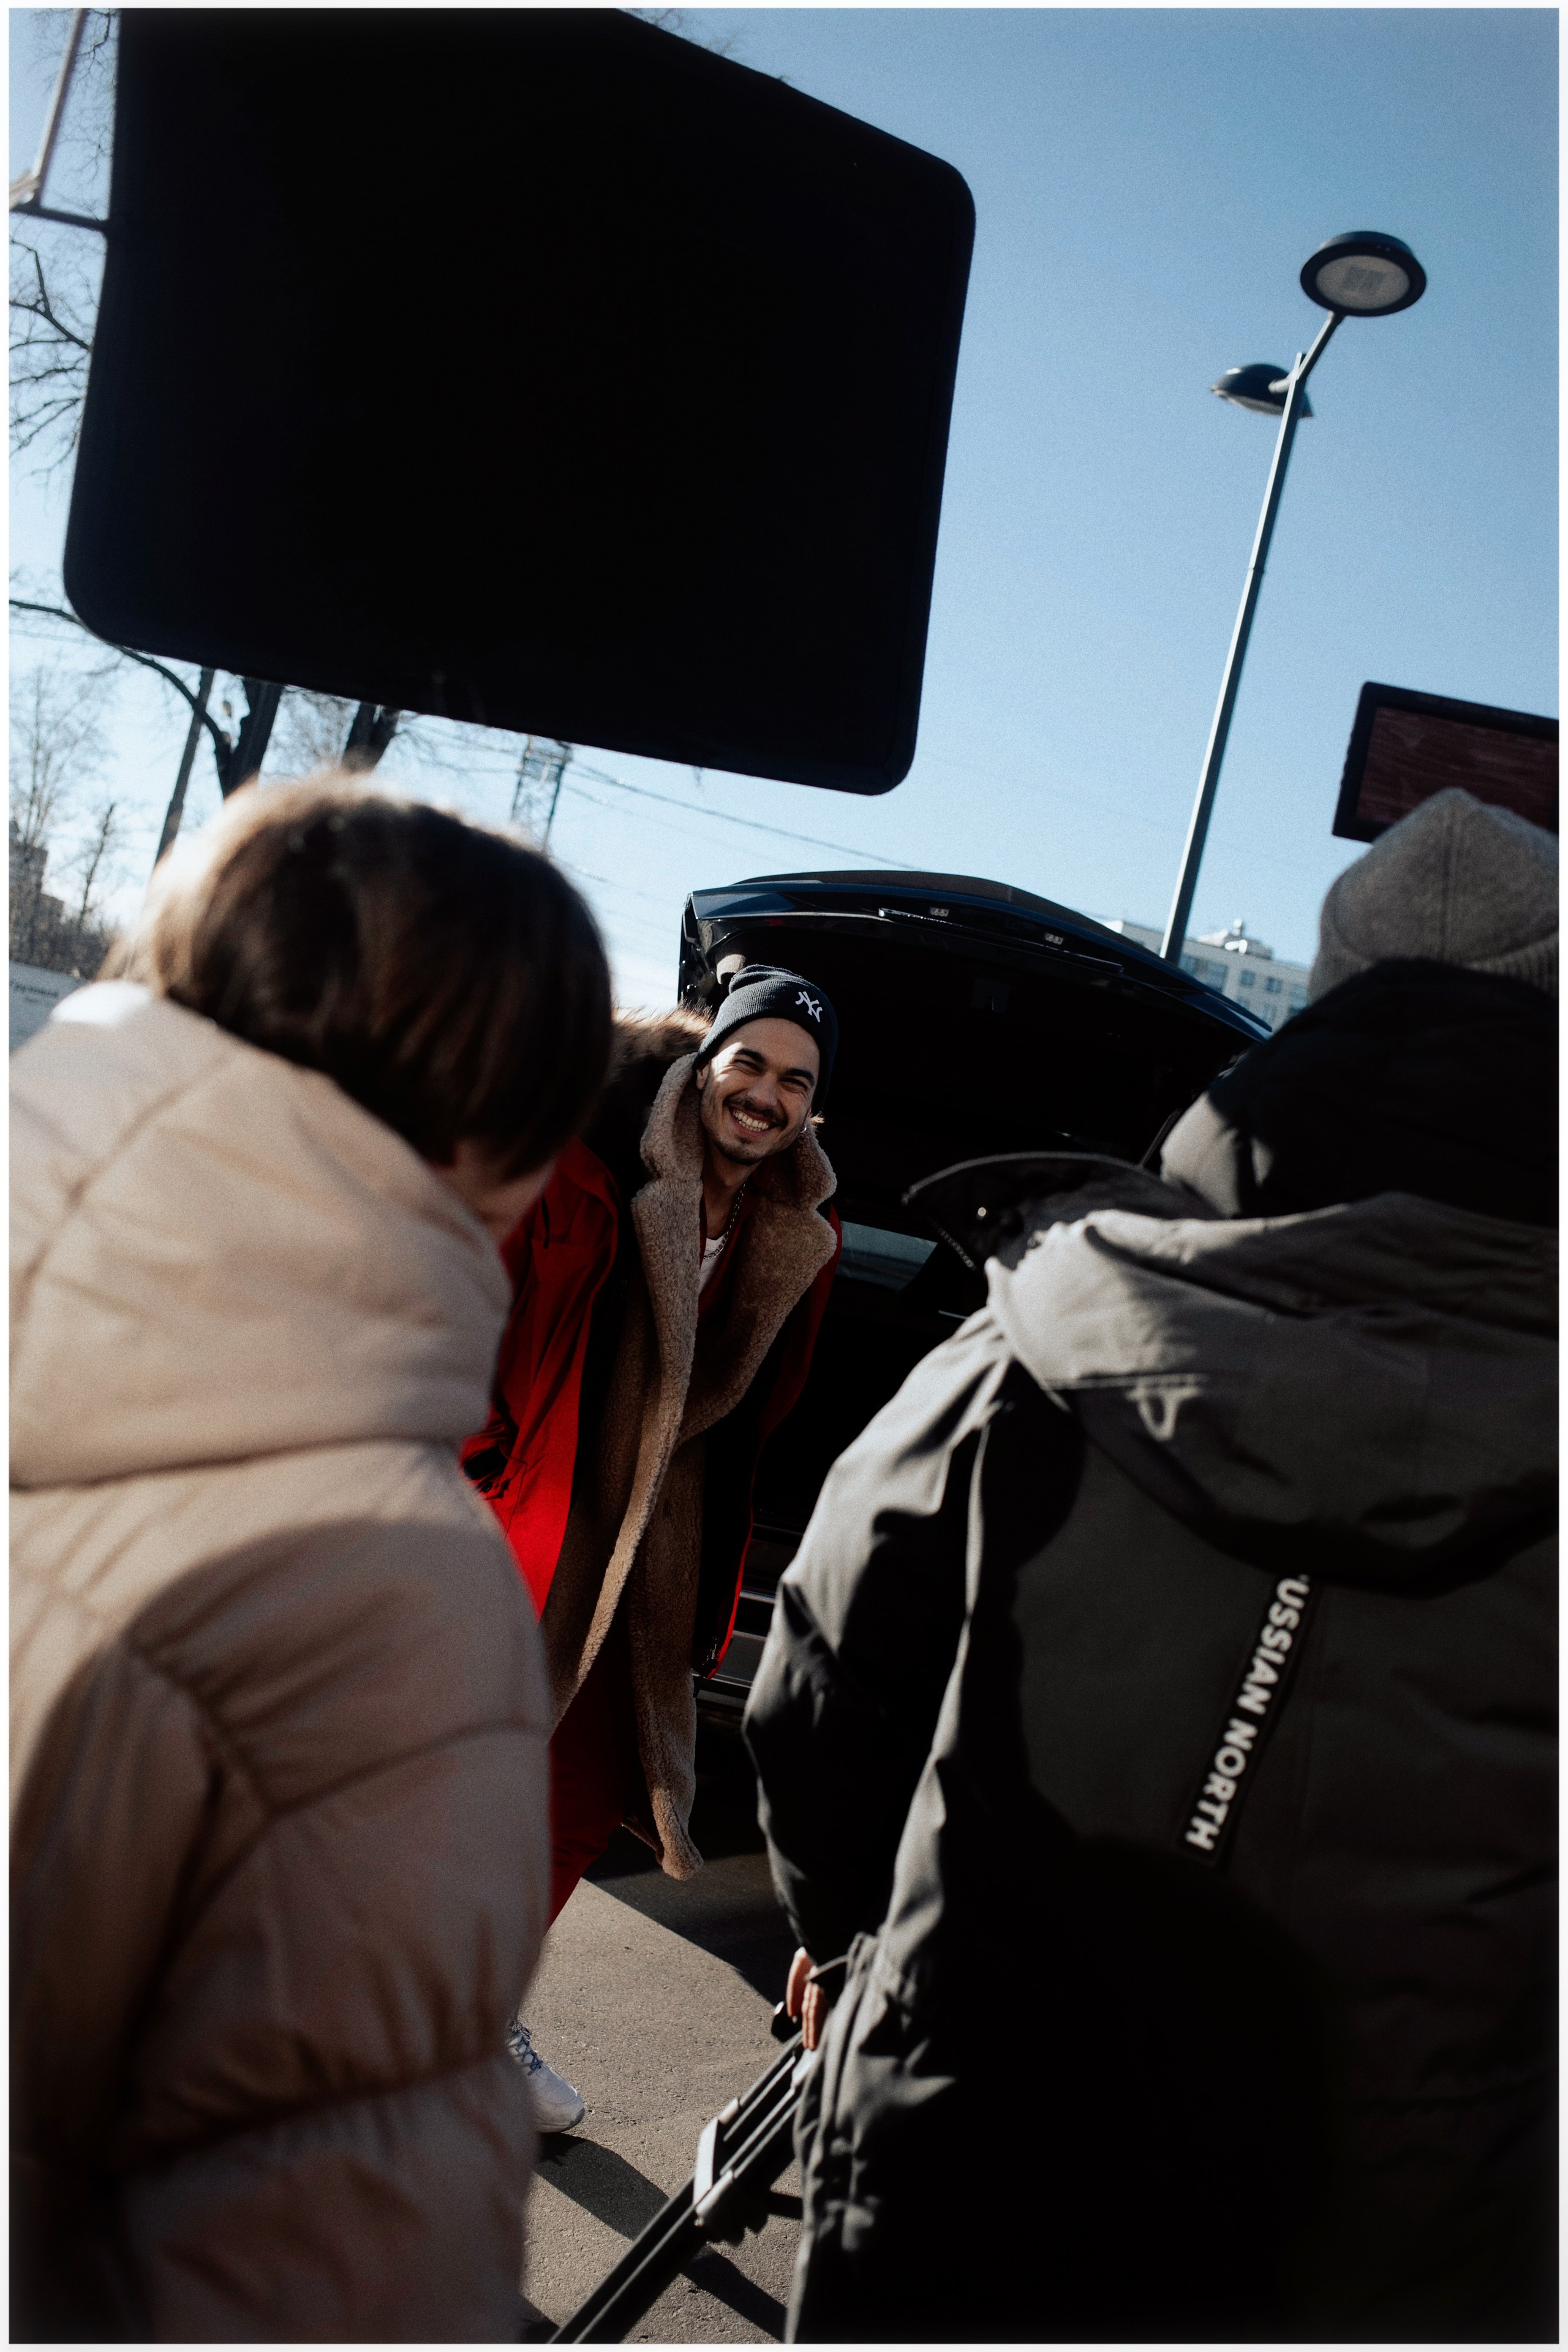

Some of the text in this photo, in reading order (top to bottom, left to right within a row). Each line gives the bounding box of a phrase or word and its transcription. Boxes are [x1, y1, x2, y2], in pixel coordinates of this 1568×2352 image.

[795, 991, 823, 1023] NY
[1185, 1574, 1310, 1850] USSIAN NORTH
